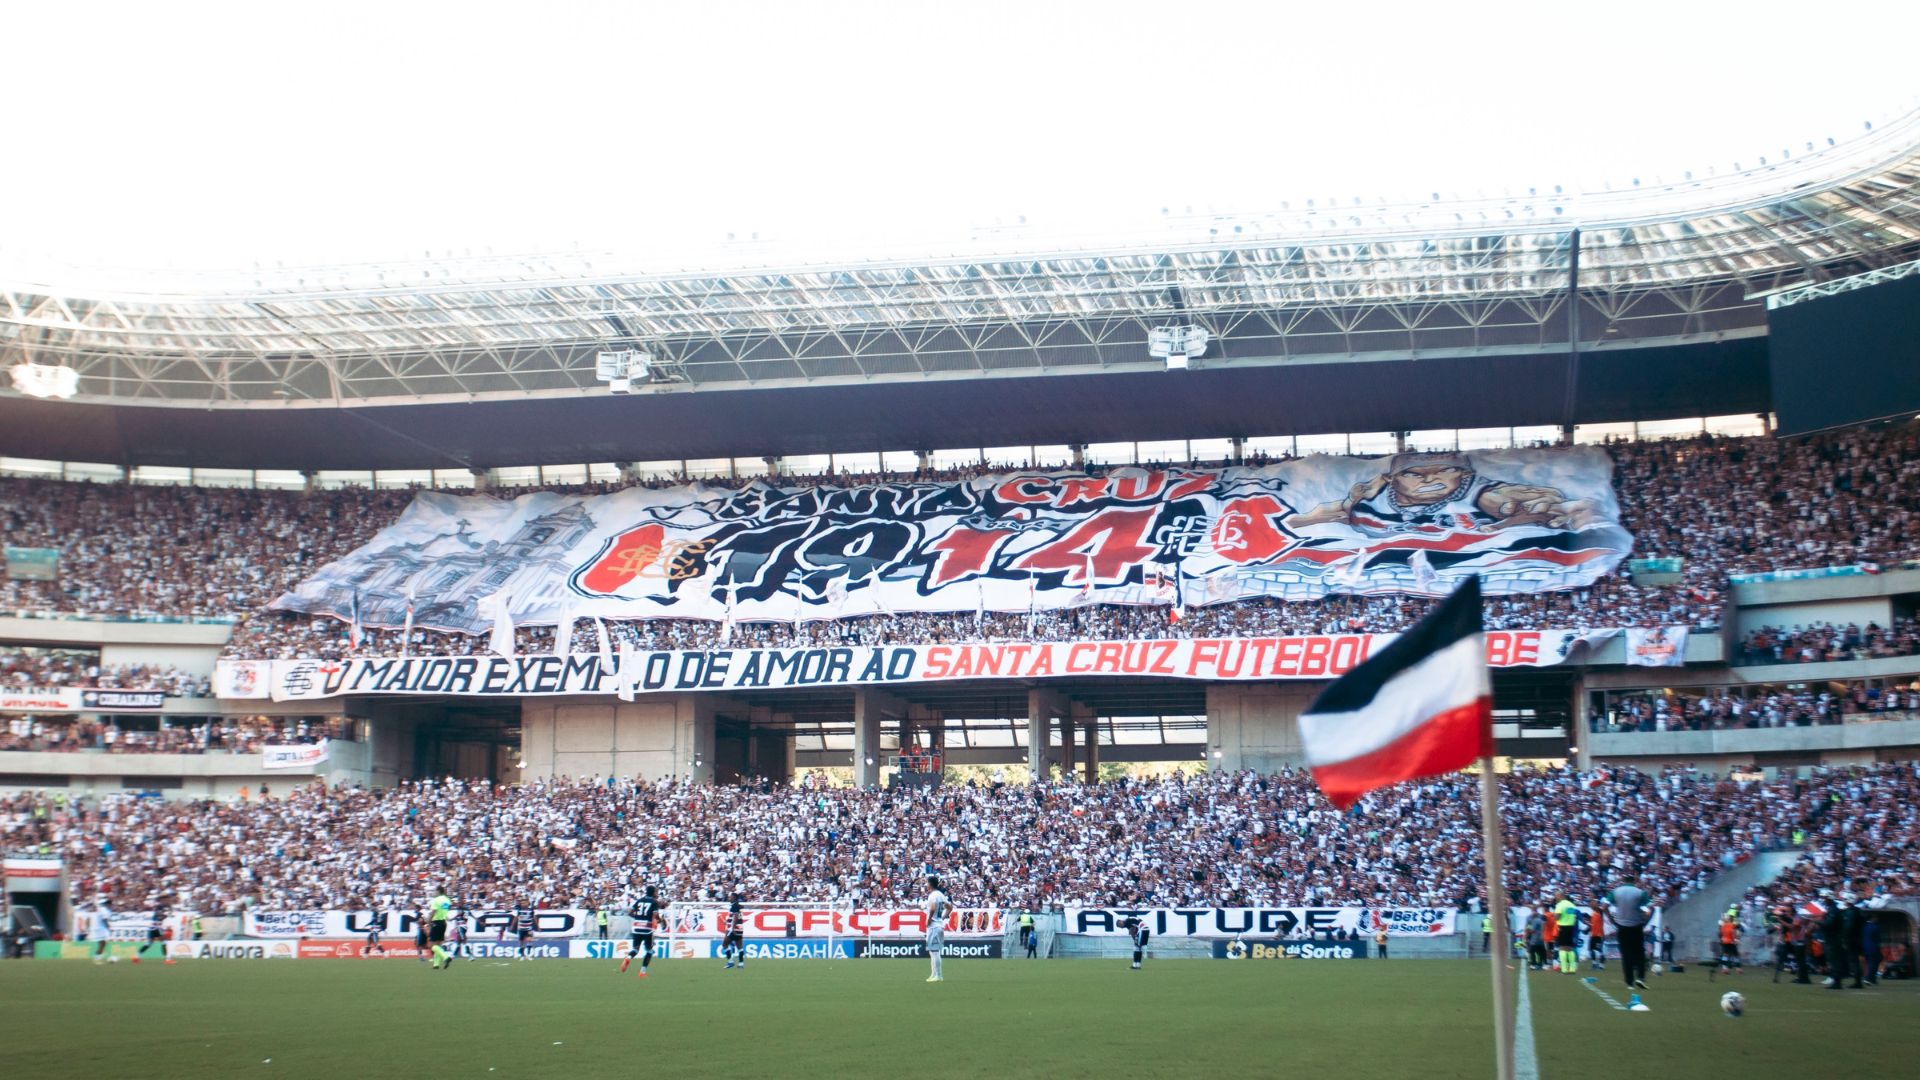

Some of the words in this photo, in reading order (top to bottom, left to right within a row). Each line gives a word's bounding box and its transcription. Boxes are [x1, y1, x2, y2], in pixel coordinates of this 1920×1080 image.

[707, 484, 978, 522] SANTA
[996, 472, 1218, 508] CRUZ
[704, 505, 1160, 600] 1914
[349, 659, 475, 692] MAIOR
[478, 652, 671, 693] EXEMPO
[674, 651, 731, 689] DE
[734, 647, 854, 686] AMOR
[860, 647, 916, 681] AO
[922, 644, 1054, 679] SANTA
[1065, 639, 1179, 674] CRUZ
[637, 902, 652, 916] 37
[1393, 910, 1418, 921] Bet
[346, 910, 575, 935] UÃO
[1077, 908, 1342, 935] ATITUDE
[1400, 923, 1429, 933] Sorte
[201, 943, 264, 959] Aurora
[586, 941, 614, 959] Sil
[864, 944, 919, 958] uhlsport
[940, 944, 989, 958] hlsport
[1252, 943, 1285, 959] Bet
[1301, 943, 1353, 959] Sorte
